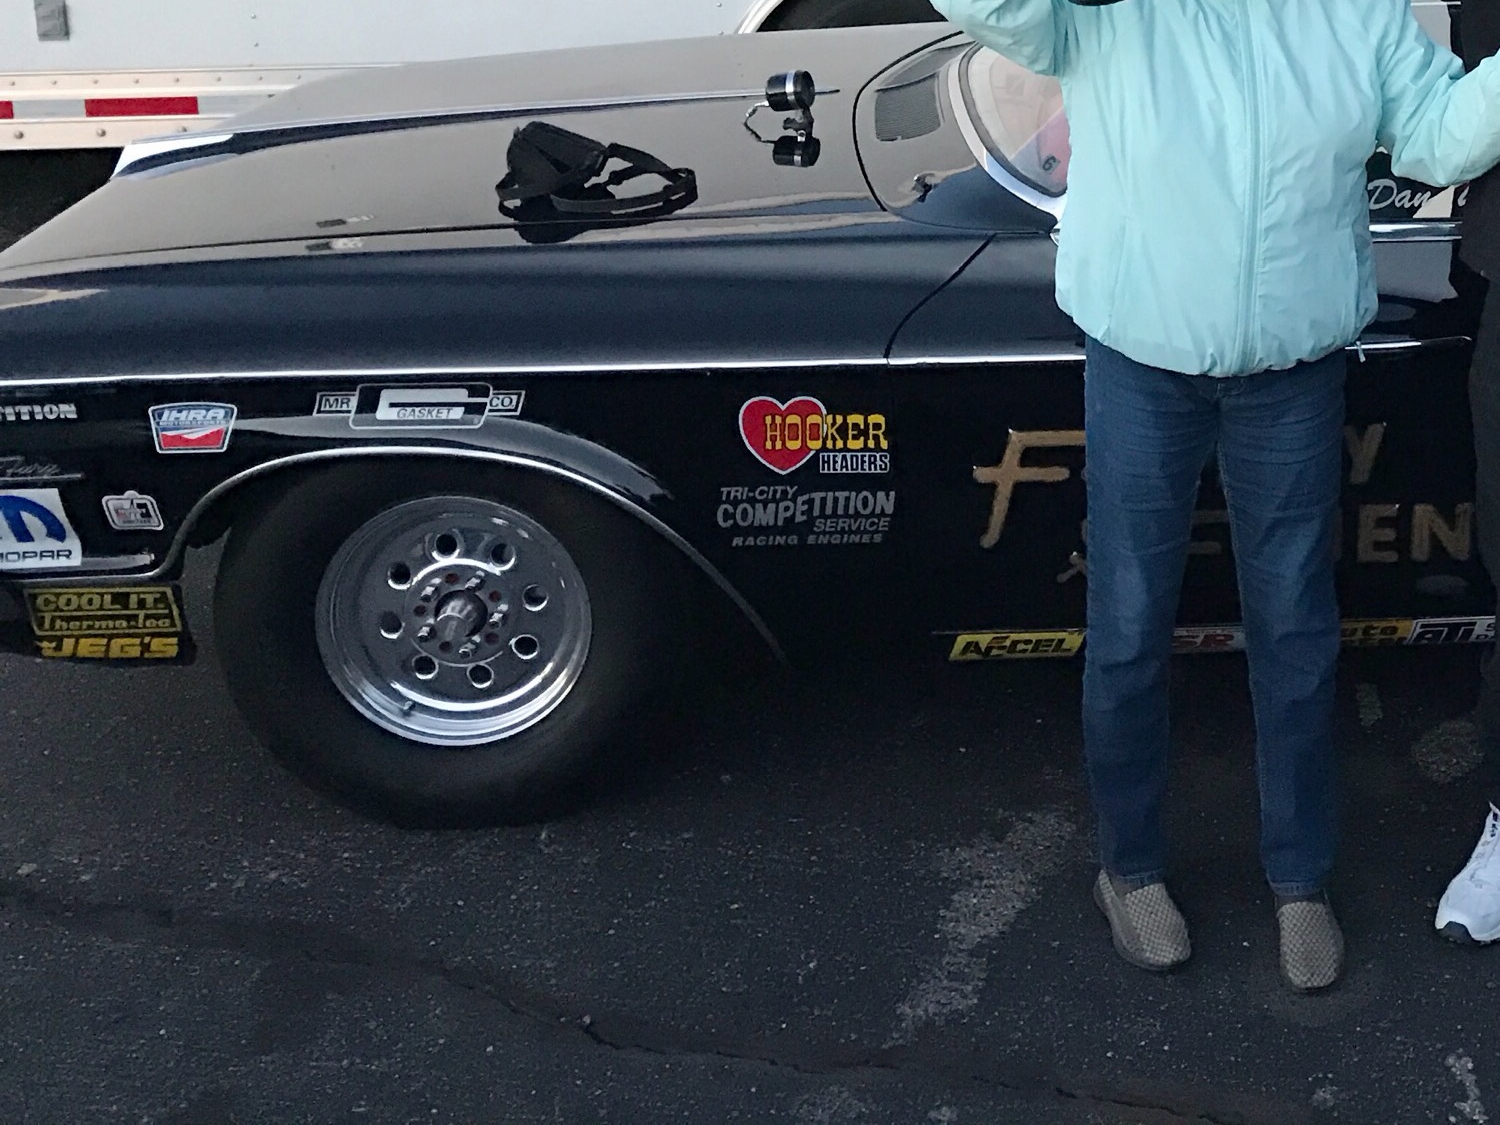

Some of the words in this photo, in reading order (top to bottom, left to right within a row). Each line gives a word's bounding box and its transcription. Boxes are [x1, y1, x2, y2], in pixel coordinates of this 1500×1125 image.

[159, 407, 225, 421] IHRA
[397, 407, 454, 419] GASKET
[488, 395, 515, 409] CO.
[764, 413, 889, 450] HOOKER
[819, 452, 890, 473] HEADERS
[720, 485, 799, 501] TRI-CITY
[716, 490, 897, 528] COMPETITION
[813, 517, 892, 533] SERVICE
[731, 534, 799, 547] RACING
[806, 533, 884, 545] ENGINES
[36, 591, 121, 611] COOL
[38, 636, 180, 658] JEG'S
